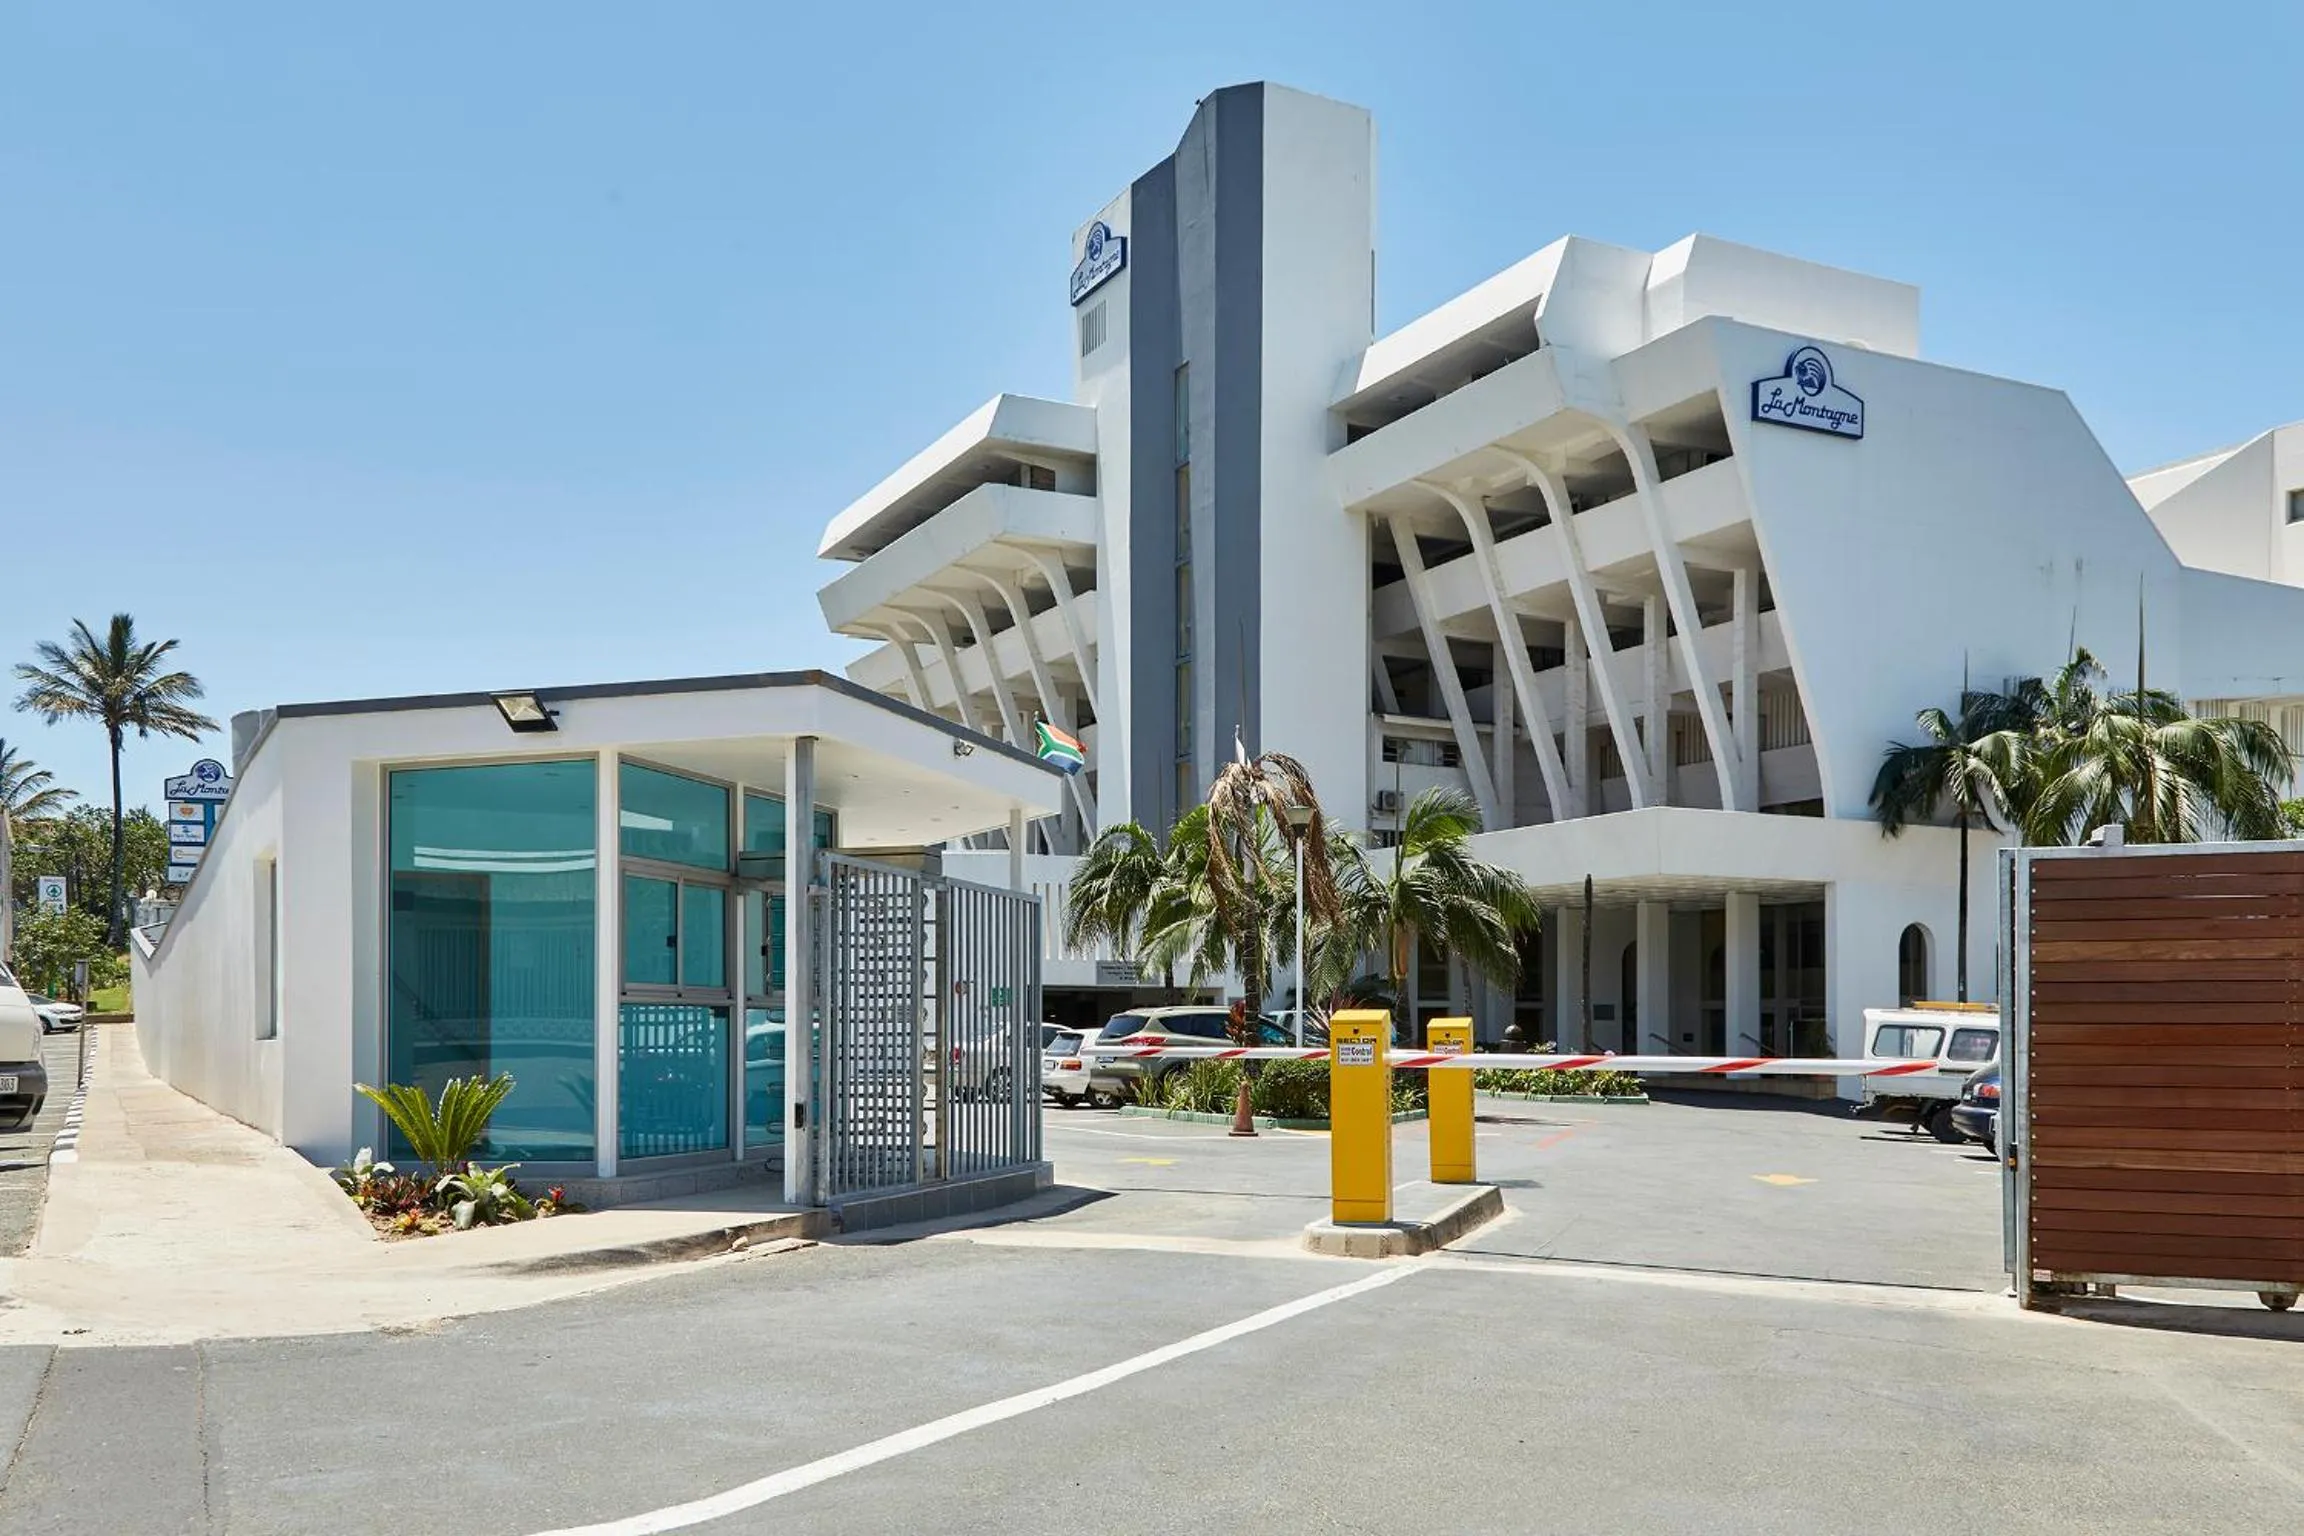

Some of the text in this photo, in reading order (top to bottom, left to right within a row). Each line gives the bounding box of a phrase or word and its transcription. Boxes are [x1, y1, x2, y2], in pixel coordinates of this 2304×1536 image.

[1761, 387, 1858, 429] La Montagne
[170, 780, 229, 796] La Monta
